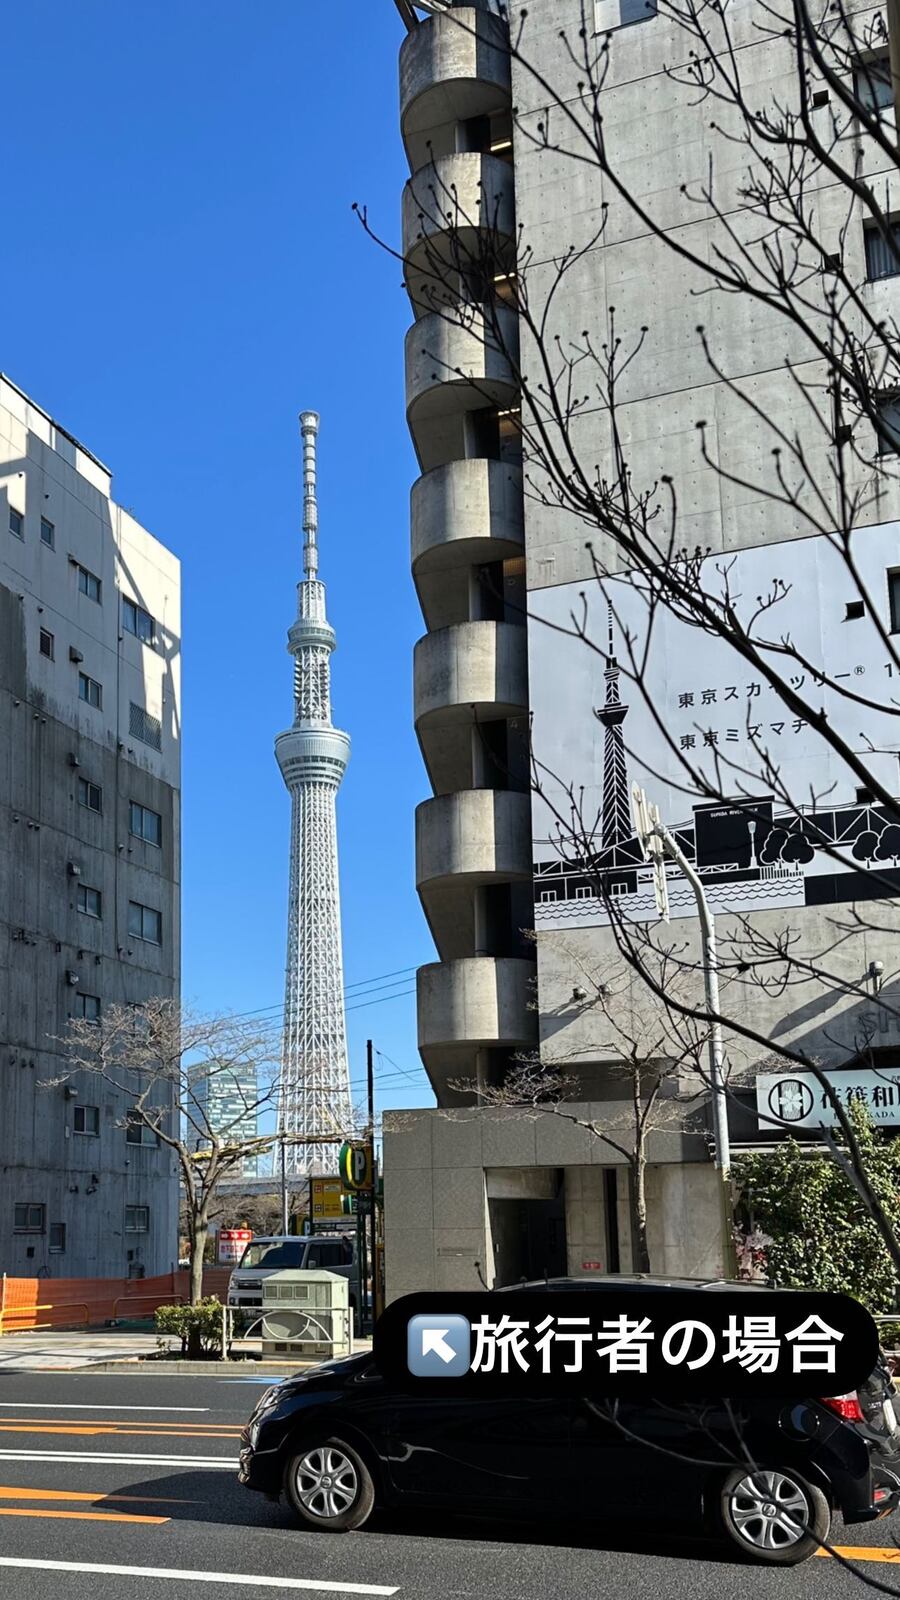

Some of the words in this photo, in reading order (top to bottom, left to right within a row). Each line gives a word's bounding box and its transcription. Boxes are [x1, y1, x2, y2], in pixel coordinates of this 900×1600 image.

[678, 664, 865, 709] 東京スカツリー®
[354, 1150, 366, 1181] P
